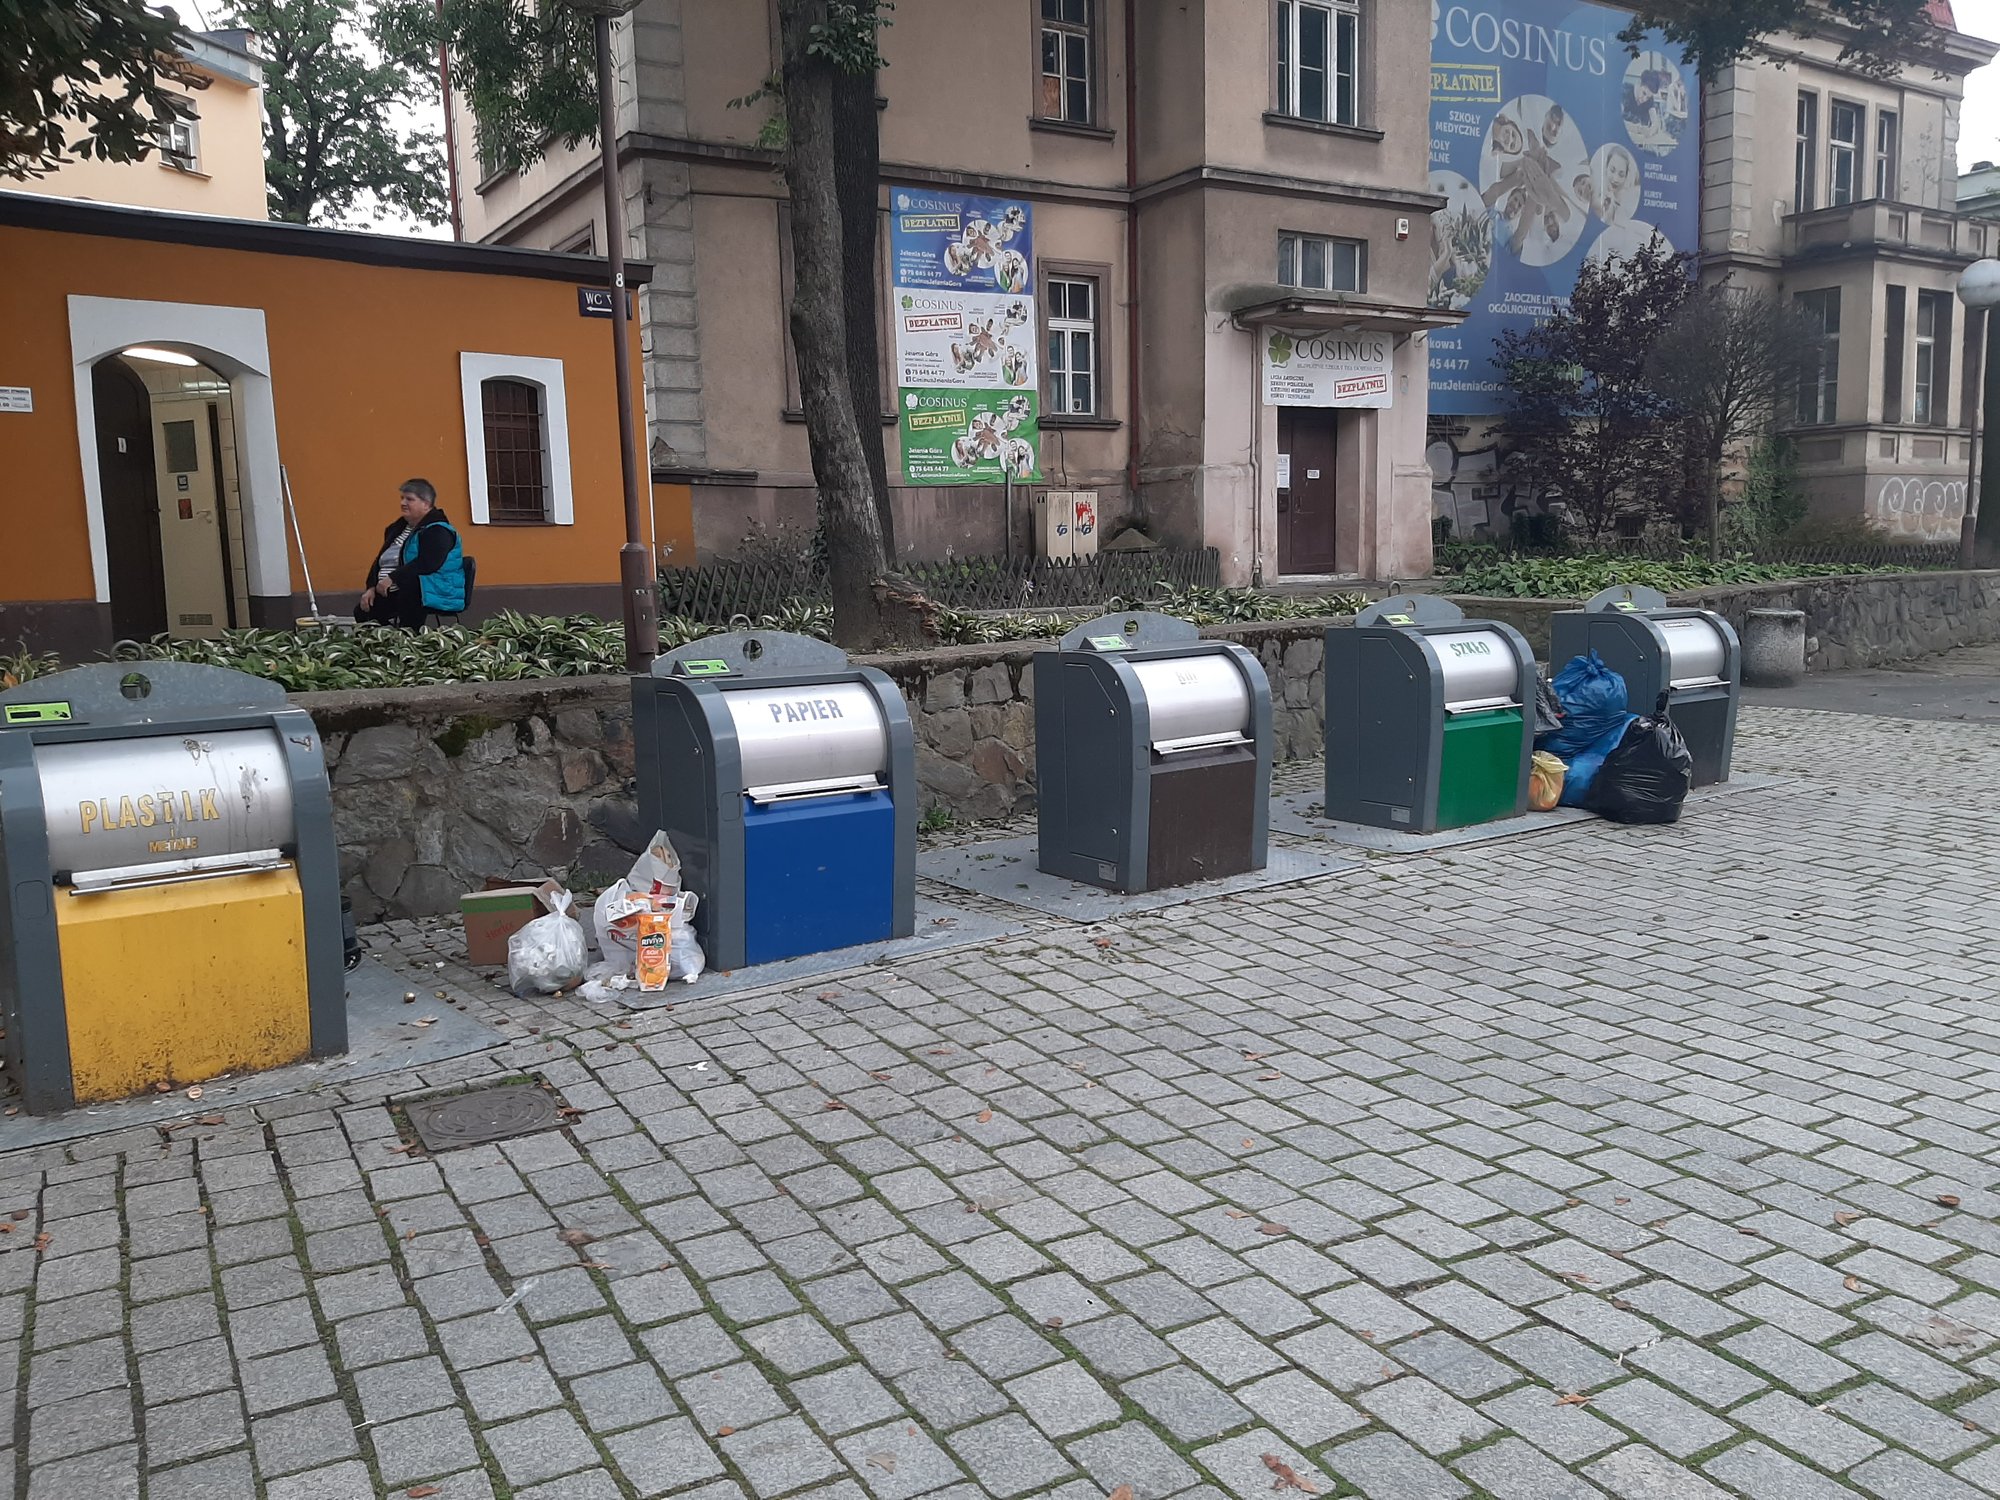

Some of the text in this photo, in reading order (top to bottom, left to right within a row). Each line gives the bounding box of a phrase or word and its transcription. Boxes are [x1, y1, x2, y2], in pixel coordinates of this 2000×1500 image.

[1446, 6, 1605, 75] COSINUS
[1449, 110, 1481, 125] SZKOŁY
[1435, 121, 1481, 137] MEDYCZNE
[911, 199, 962, 213] COSINUS
[615, 272, 624, 288] 8
[585, 292, 603, 305] WC
[914, 299, 964, 311] COSINUS
[1504, 292, 1541, 304] ZAOCZNE
[1295, 339, 1384, 363] COSINUS
[1443, 359, 1456, 371] 44
[1458, 359, 1470, 370] 77
[1337, 380, 1384, 394] BEZPŁATNIE
[919, 397, 967, 408] COSINUS
[1450, 641, 1490, 657] SZKŁO
[768, 699, 844, 723] PAPIER
[79, 788, 221, 834] PLASTIK
